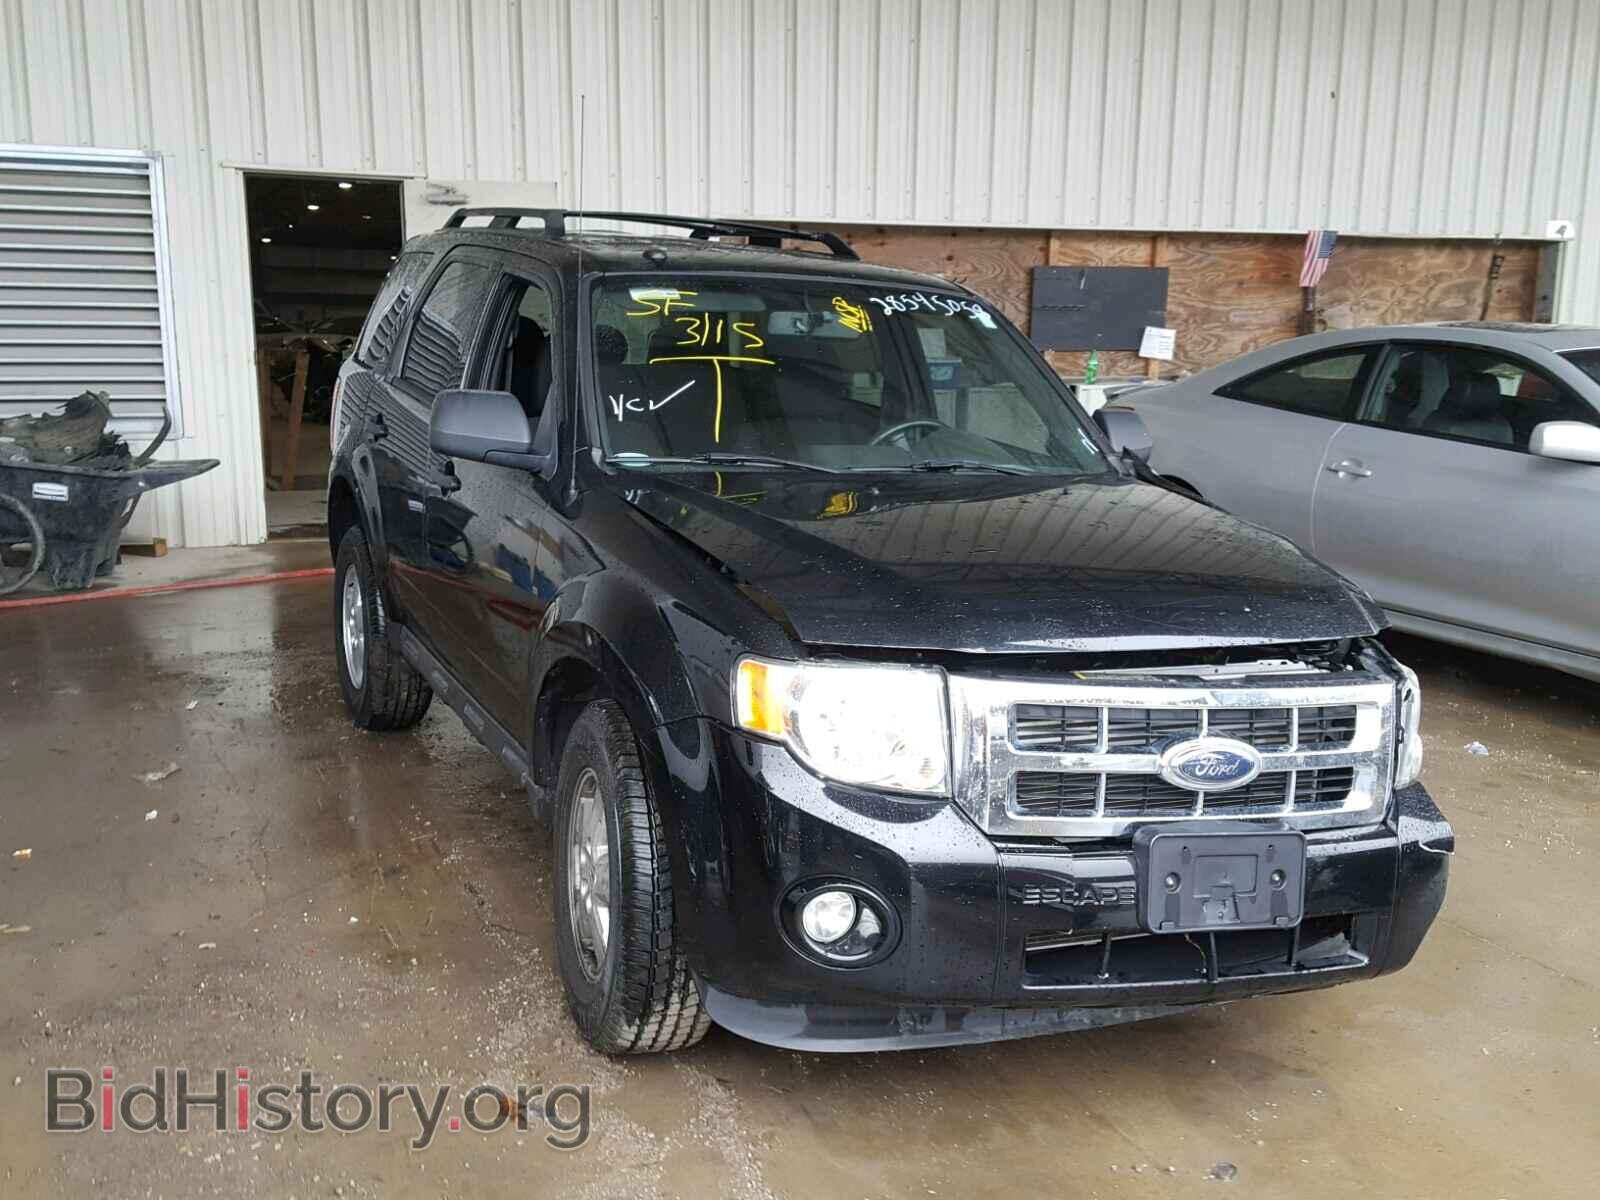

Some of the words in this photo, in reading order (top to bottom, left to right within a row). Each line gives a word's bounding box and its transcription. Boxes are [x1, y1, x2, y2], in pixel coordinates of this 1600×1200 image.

[626, 289, 698, 316] SF
[1183, 753, 1241, 776] Ford
[1022, 888, 1136, 905] ESCAPE
